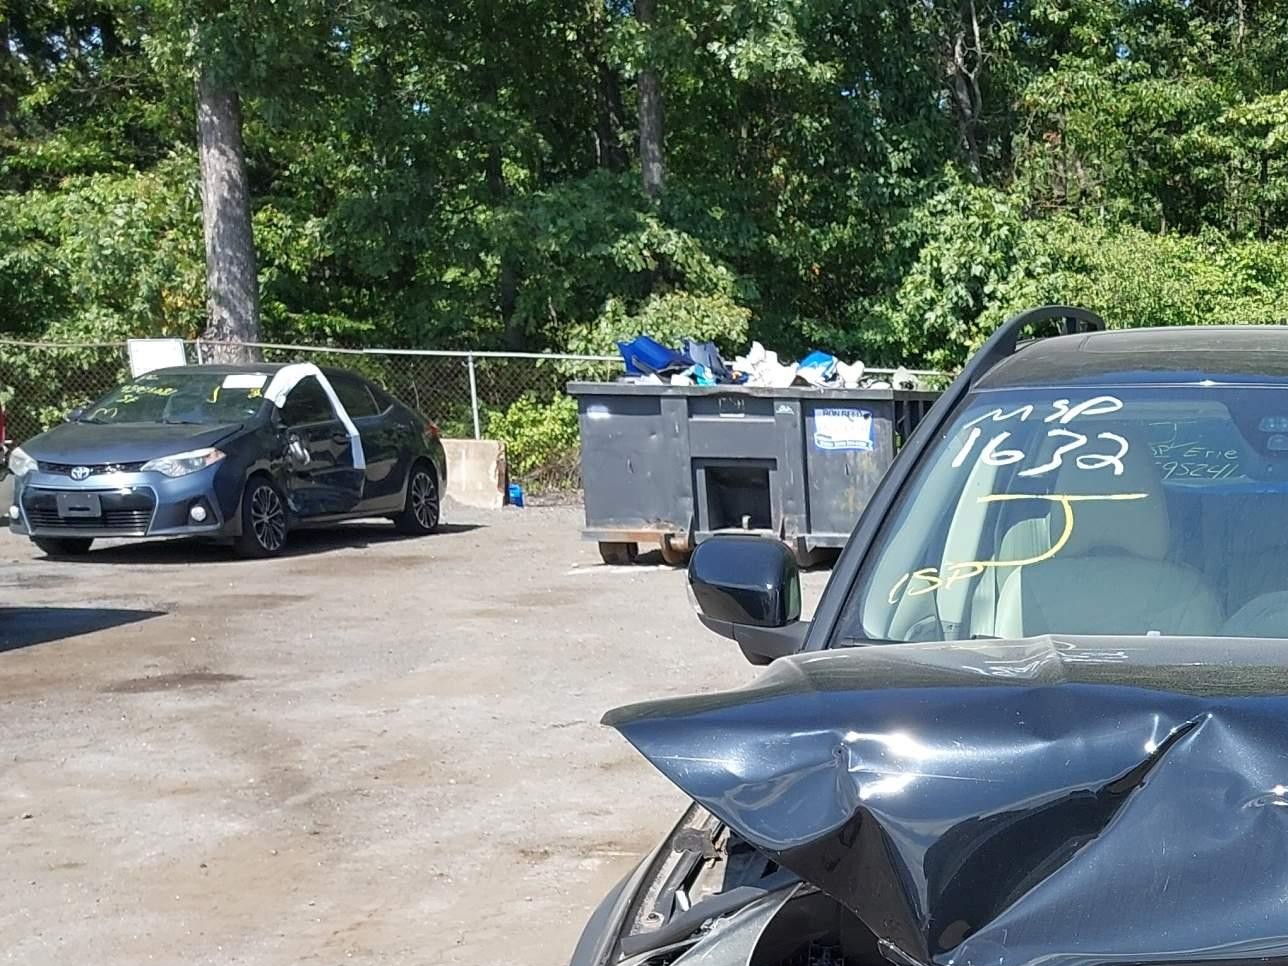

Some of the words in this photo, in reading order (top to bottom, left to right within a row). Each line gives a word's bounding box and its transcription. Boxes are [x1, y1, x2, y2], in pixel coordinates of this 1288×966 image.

[963, 395, 1124, 429] MSP
[951, 427, 1130, 477] 1632
[1183, 447, 1239, 460] Erie
